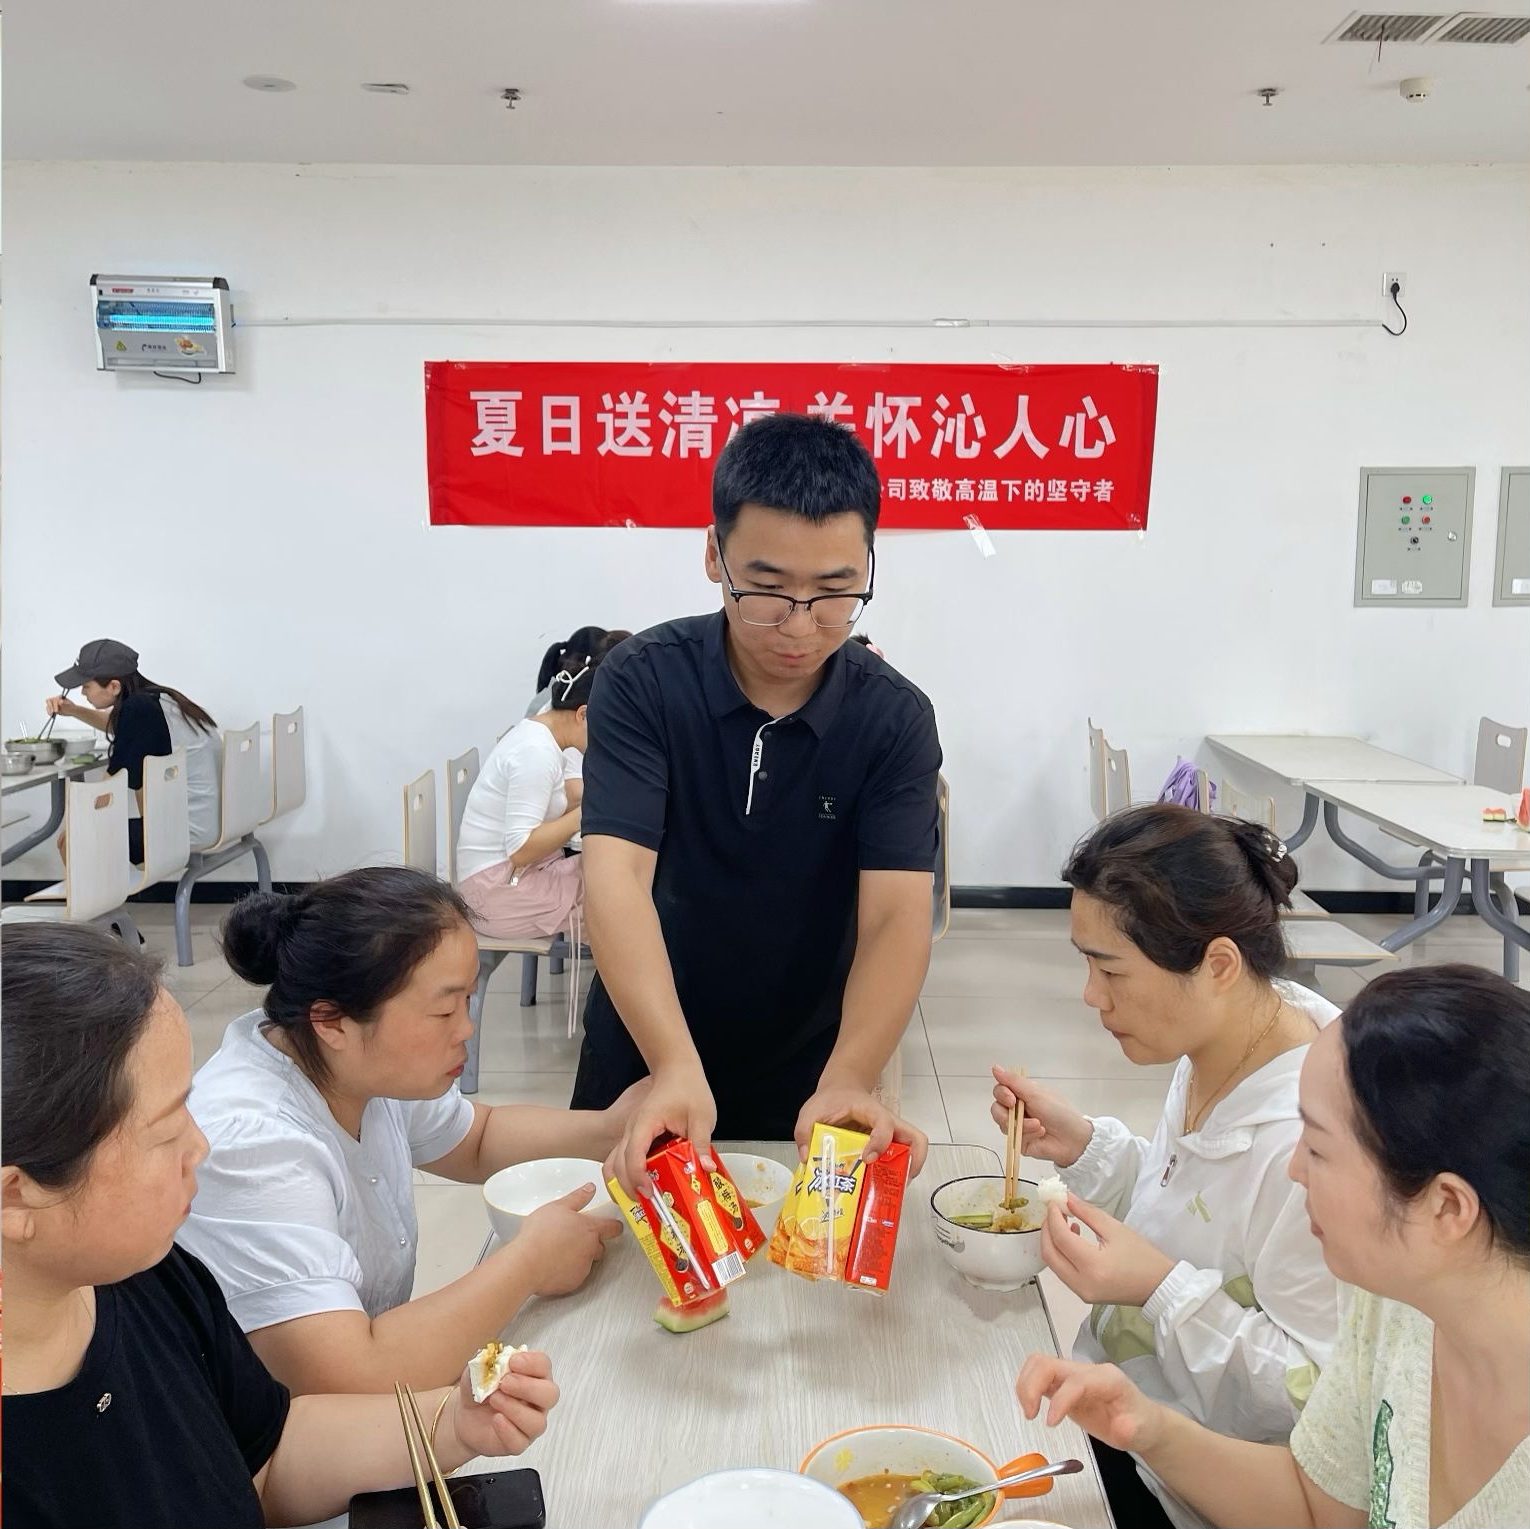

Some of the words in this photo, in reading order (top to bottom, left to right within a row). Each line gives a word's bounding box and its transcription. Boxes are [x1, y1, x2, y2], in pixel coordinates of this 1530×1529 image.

[880, 478, 1115, 503] 司致敬高温下的坚守者
